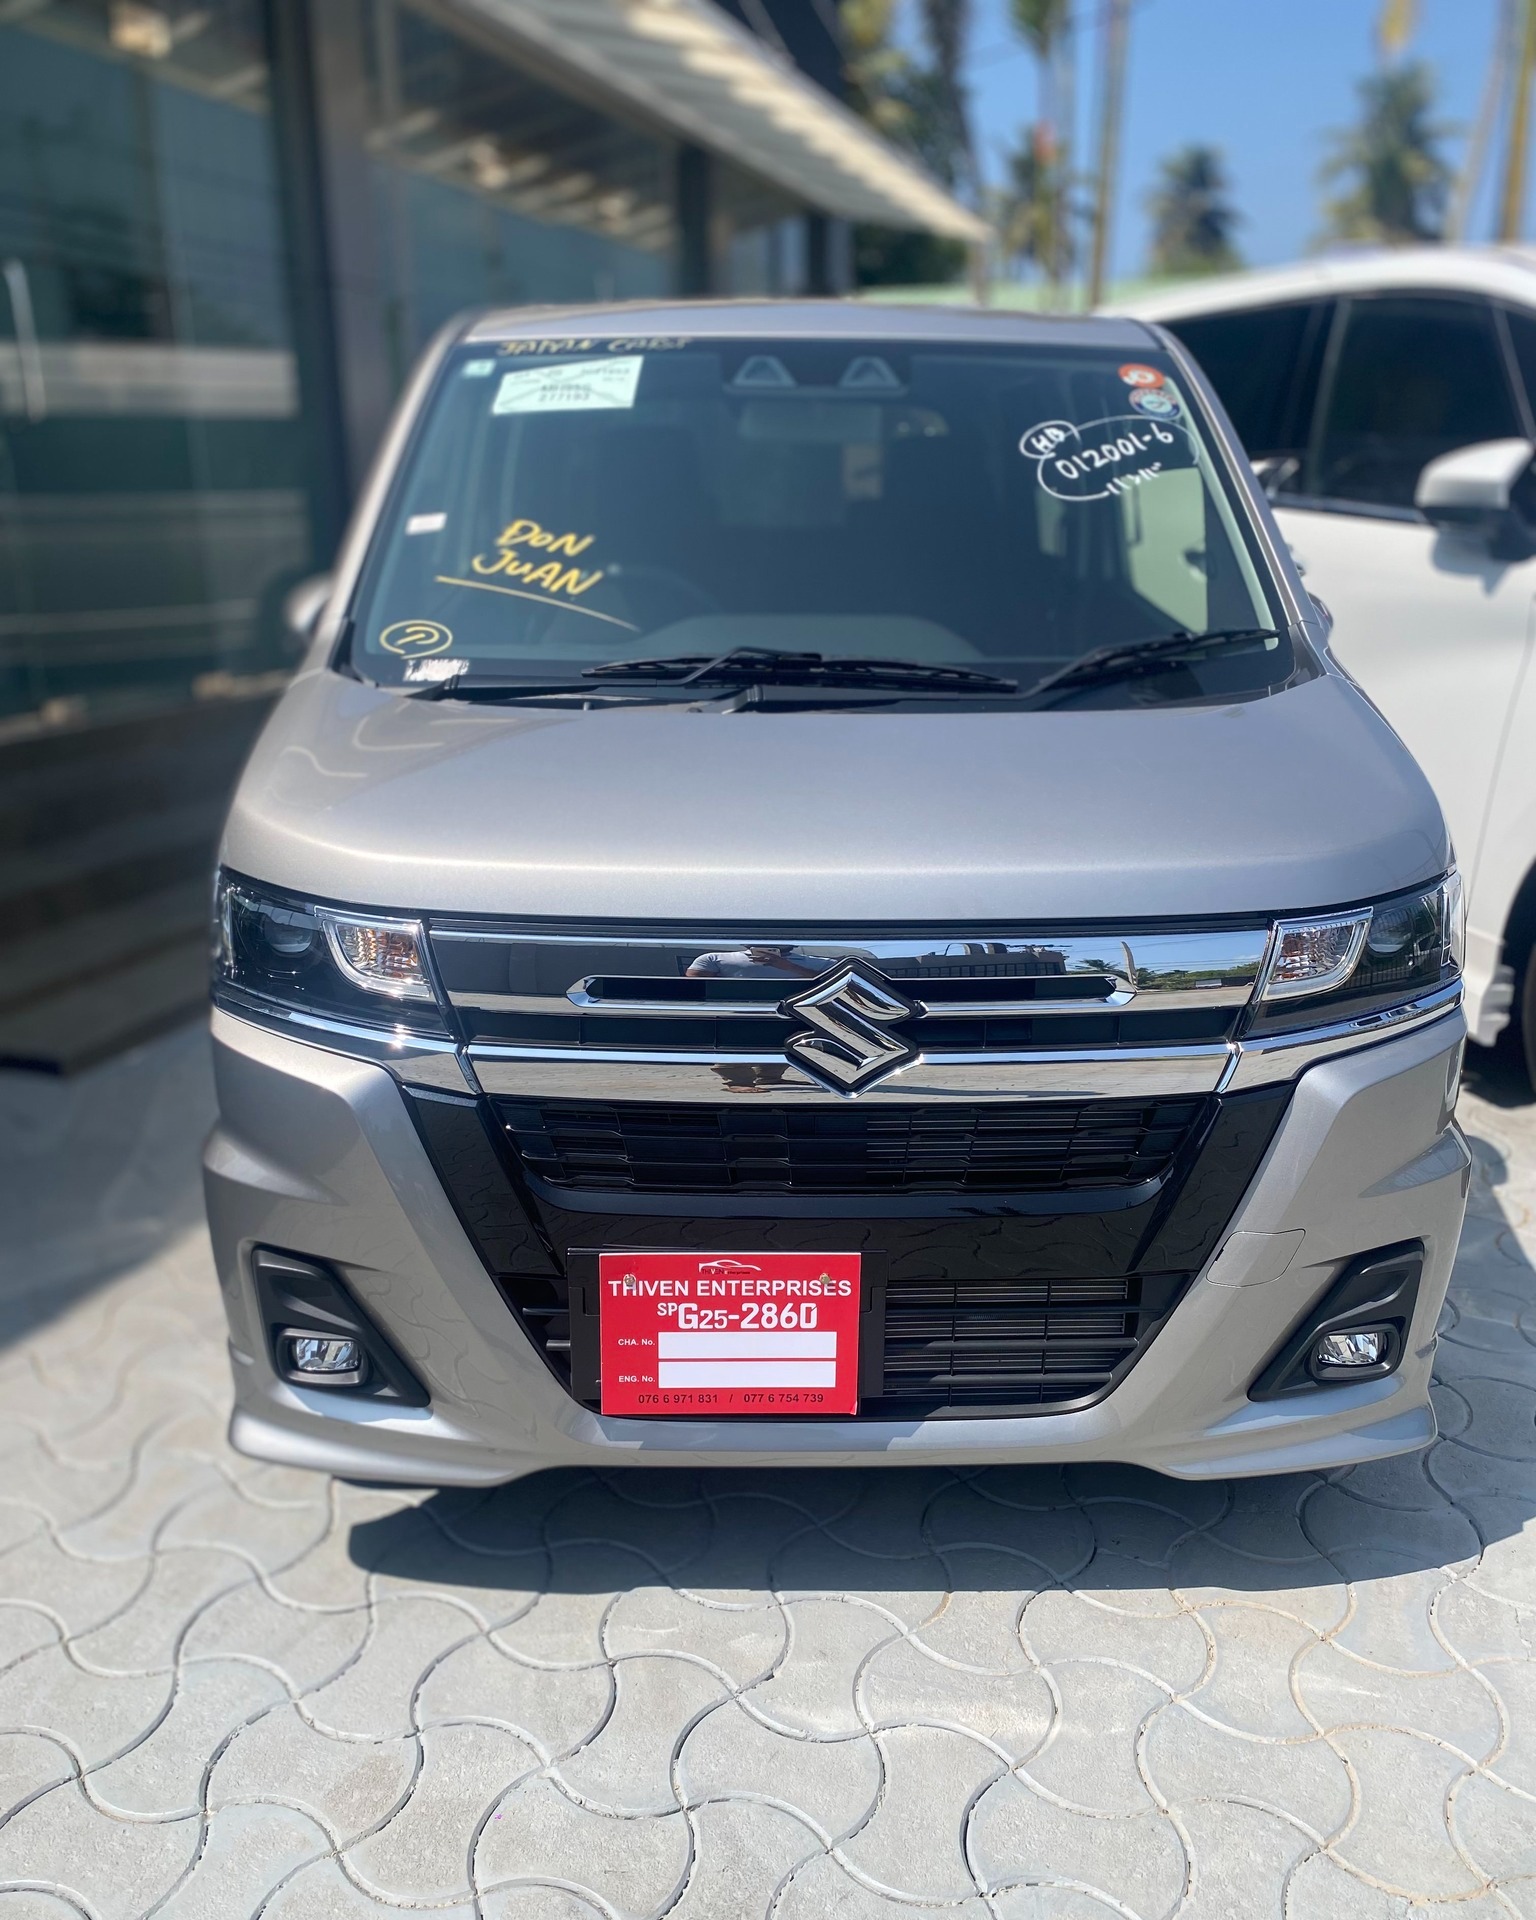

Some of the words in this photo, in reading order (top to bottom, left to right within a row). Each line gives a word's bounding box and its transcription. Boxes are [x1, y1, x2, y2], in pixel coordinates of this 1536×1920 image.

[1055, 422, 1174, 480] 012001-6
[608, 1280, 689, 1297] THIVEN
[697, 1280, 852, 1297] ENTERPRISES
[618, 1338, 639, 1346] CHA.
[641, 1338, 656, 1346] No.
[618, 1375, 640, 1383] ENG.
[641, 1375, 656, 1383] No.
[638, 1394, 660, 1404] 076
[663, 1394, 670, 1404] 6
[673, 1394, 693, 1404] 971
[698, 1394, 718, 1404] 831
[743, 1393, 765, 1403] 077
[768, 1393, 775, 1403] 6
[778, 1393, 799, 1403] 754
[803, 1393, 824, 1403] 739
